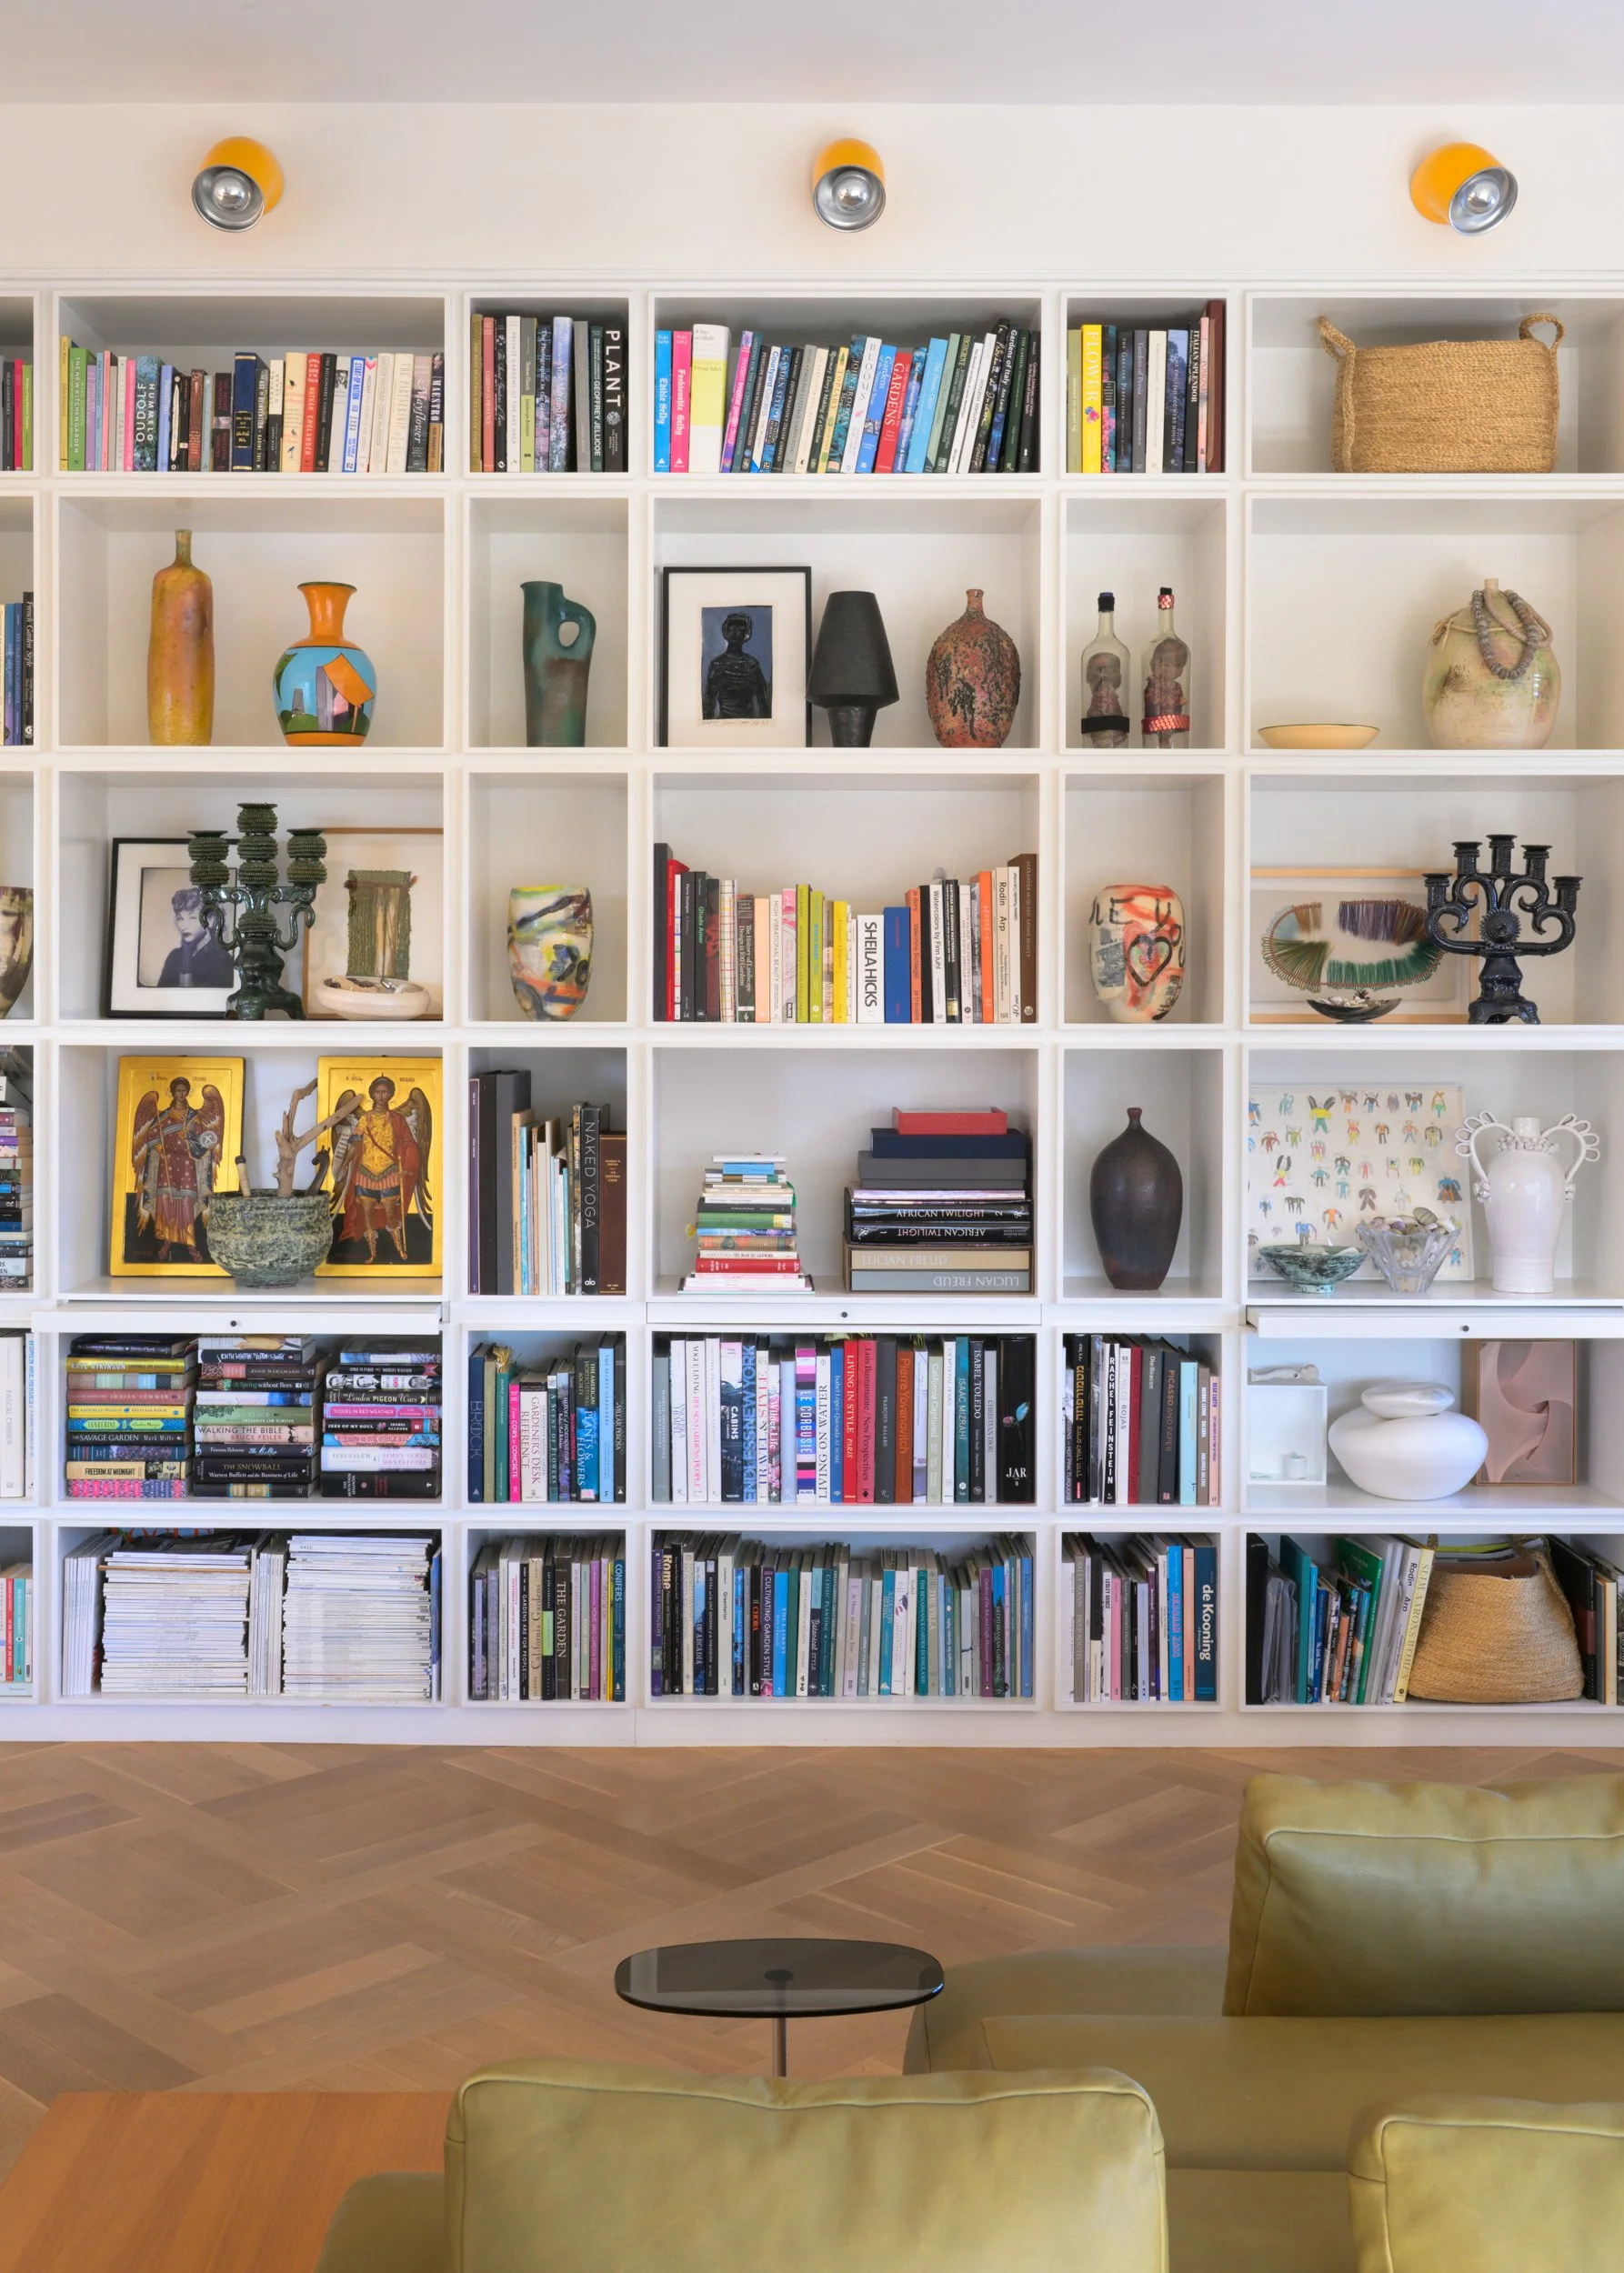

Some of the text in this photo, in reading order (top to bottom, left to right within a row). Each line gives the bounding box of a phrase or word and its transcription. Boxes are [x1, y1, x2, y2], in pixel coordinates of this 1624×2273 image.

[606, 329, 621, 407] PLANT
[767, 351, 779, 387] Courtyard
[879, 356, 892, 389] Gardens
[957, 335, 971, 366] HIGHGROVE
[1002, 330, 1018, 386] Gardens of Italy
[1086, 331, 1099, 402] FLOWER
[431, 379, 442, 422] MAESTRO
[658, 377, 668, 425] Edible Selby
[676, 369, 687, 436] Fashionable Selby
[842, 359, 861, 426] JOHN BROOKES
[885, 363, 905, 425] GARDENS
[1191, 362, 1199, 403] SPLENDOR
[135, 383, 145, 443] OUDOLF
[305, 387, 316, 456] NATHAN ENGLANDER
[414, 379, 428, 445] Mayflower
[594, 380, 602, 456] GEOFFREY JELLICOE
[24, 601, 34, 667] French Garden Style
[697, 906, 705, 926] Ghada
[933, 890, 942, 930] Watercolors
[997, 882, 1007, 932] Rodin Arp
[933, 931, 942, 940] by
[934, 941, 942, 955] Finn
[864, 922, 877, 1006] SHEILA HICKS
[584, 1122, 596, 1229] NAKED YOGA
[896, 1209, 938, 1218] AFRICAN
[940, 1209, 986, 1218] TWILIGHT
[897, 1228, 987, 1237] AFRICAN TWILIGHT
[861, 1255, 948, 1266] LUCIAN FREUD
[933, 1276, 1019, 1287] LUCIAN FREUD
[742, 1345, 757, 1386] YORK
[847, 1355, 855, 1388] LIVING
[973, 1349, 982, 1419] ISABEL TOLEDO
[800, 1391, 812, 1401] LE
[847, 1390, 855, 1401] IN
[847, 1403, 855, 1434] STYLE
[861, 1347, 872, 1481] Luis Bustamante New Perspectives
[899, 1357, 911, 1455] Pierre Yovanovitch
[928, 1363, 939, 1438] California Captured
[958, 1377, 967, 1440] ISAAC MIZRAHI
[1119, 1404, 1128, 1430] ROJAS
[1164, 1369, 1176, 1452] PICASSO AND PAPER
[79, 1433, 106, 1442] SAVAGE
[108, 1433, 139, 1442] GARDEN
[198, 1426, 283, 1435] WALKING THE BIBLE
[520, 1410, 530, 1469] REFERENCE
[531, 1397, 541, 1485] GARDENER'S DESK
[584, 1410, 594, 1449] PLANTS
[730, 1406, 739, 1440] CABINS
[768, 1399, 778, 1450] Wilder Life
[818, 1385, 827, 1499] LIVING ON WATER
[987, 1399, 995, 1453] CHRISTIAN DIOR
[1106, 1357, 1116, 1485] RACHEL FEINSTEIN
[85, 1467, 135, 1476] FREEDOM AT MIDNIGHT
[576, 1437, 586, 1485] FLOWERS
[742, 1431, 757, 1502] ENDLESS
[1006, 1467, 1027, 1477] JAR
[614, 1564, 623, 1602] CONIFERS
[662, 1554, 674, 1590] Rome
[1402, 1562, 1418, 1612] Rodin Arp
[530, 1584, 541, 1669] California Gardens
[556, 1581, 566, 1658] THE GARDEN
[763, 1576, 773, 1677] CULTIVATING GARDEN STYLE
[928, 1588, 937, 1630] THE VILLA
[1199, 1584, 1214, 1661] de Kooning
[1399, 1563, 1430, 1681] SLIM AARONS WOMEN
[810, 1618, 820, 1651] Botanical
